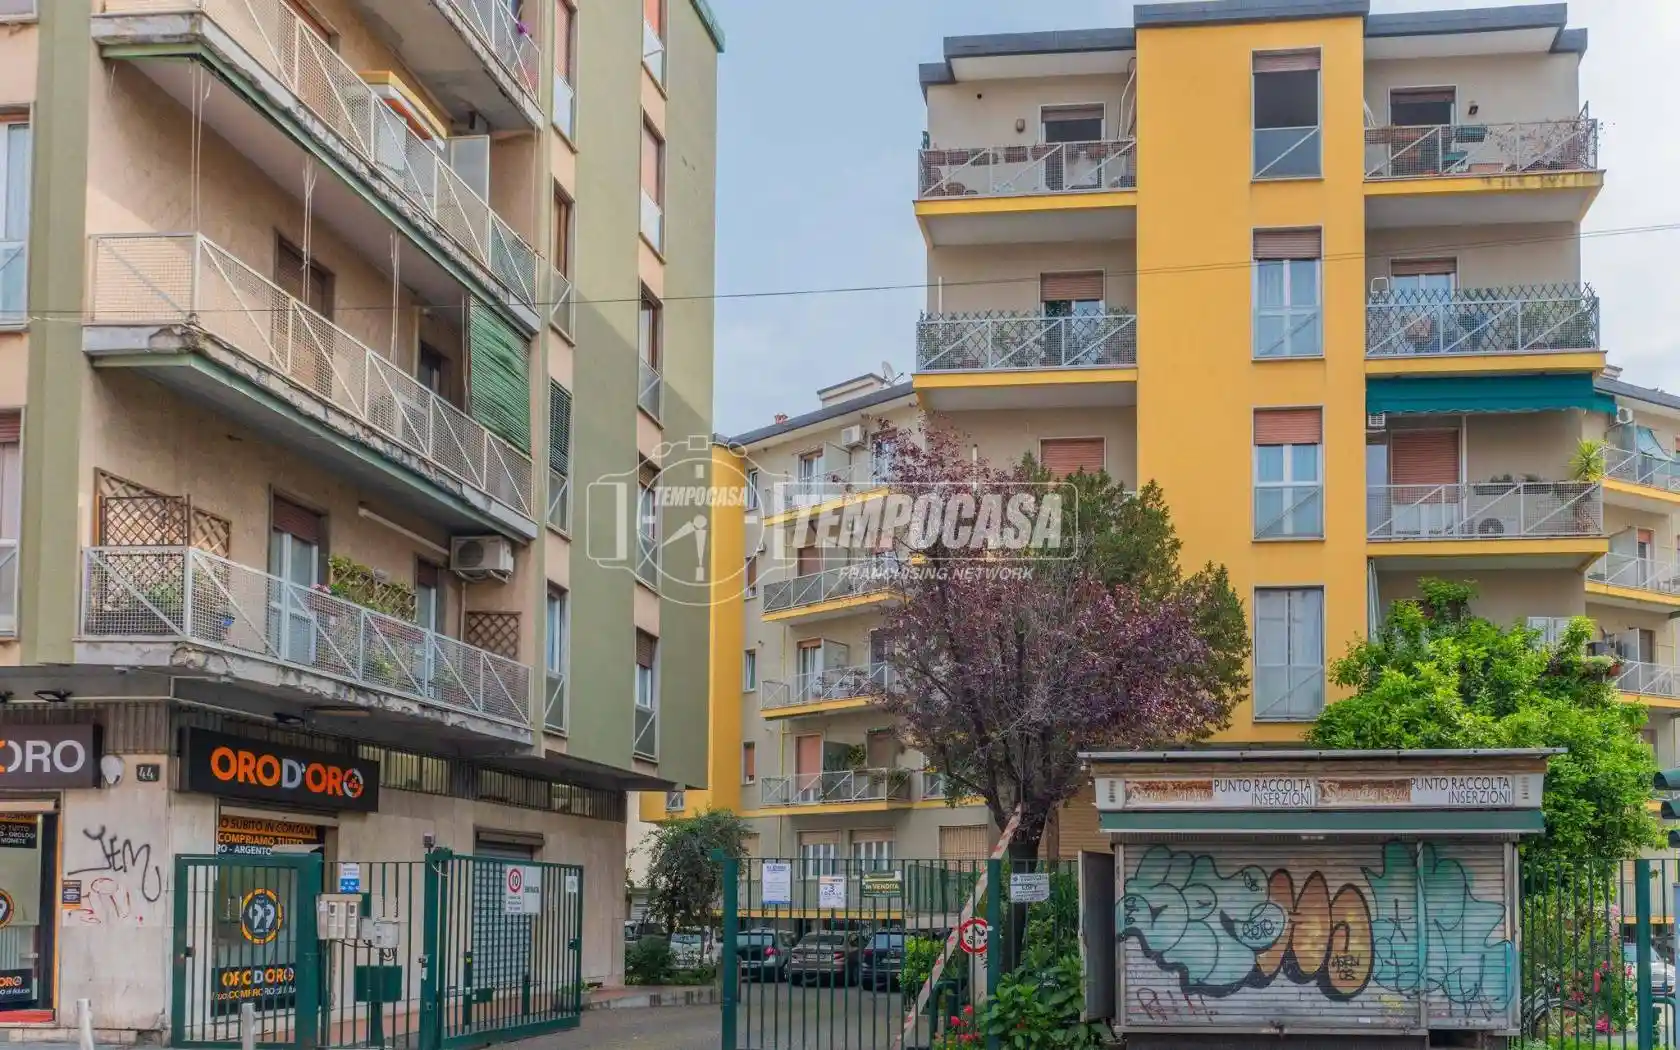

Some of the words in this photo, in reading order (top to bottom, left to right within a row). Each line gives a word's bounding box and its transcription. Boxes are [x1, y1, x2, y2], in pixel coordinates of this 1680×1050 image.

[138, 765, 155, 781] 44
[1214, 779, 1252, 793] PUNTO
[1254, 778, 1312, 792] RACCOLTA
[1410, 777, 1449, 791] PUNTO
[1451, 776, 1510, 791] RACCOLTA
[1251, 792, 1313, 806] INSERZIONI
[1448, 790, 1512, 804] INSERZIONI
[231, 818, 263, 832] SUBITO
[218, 832, 275, 846] COMPRIAMO
[234, 845, 273, 856] ARGENTO
